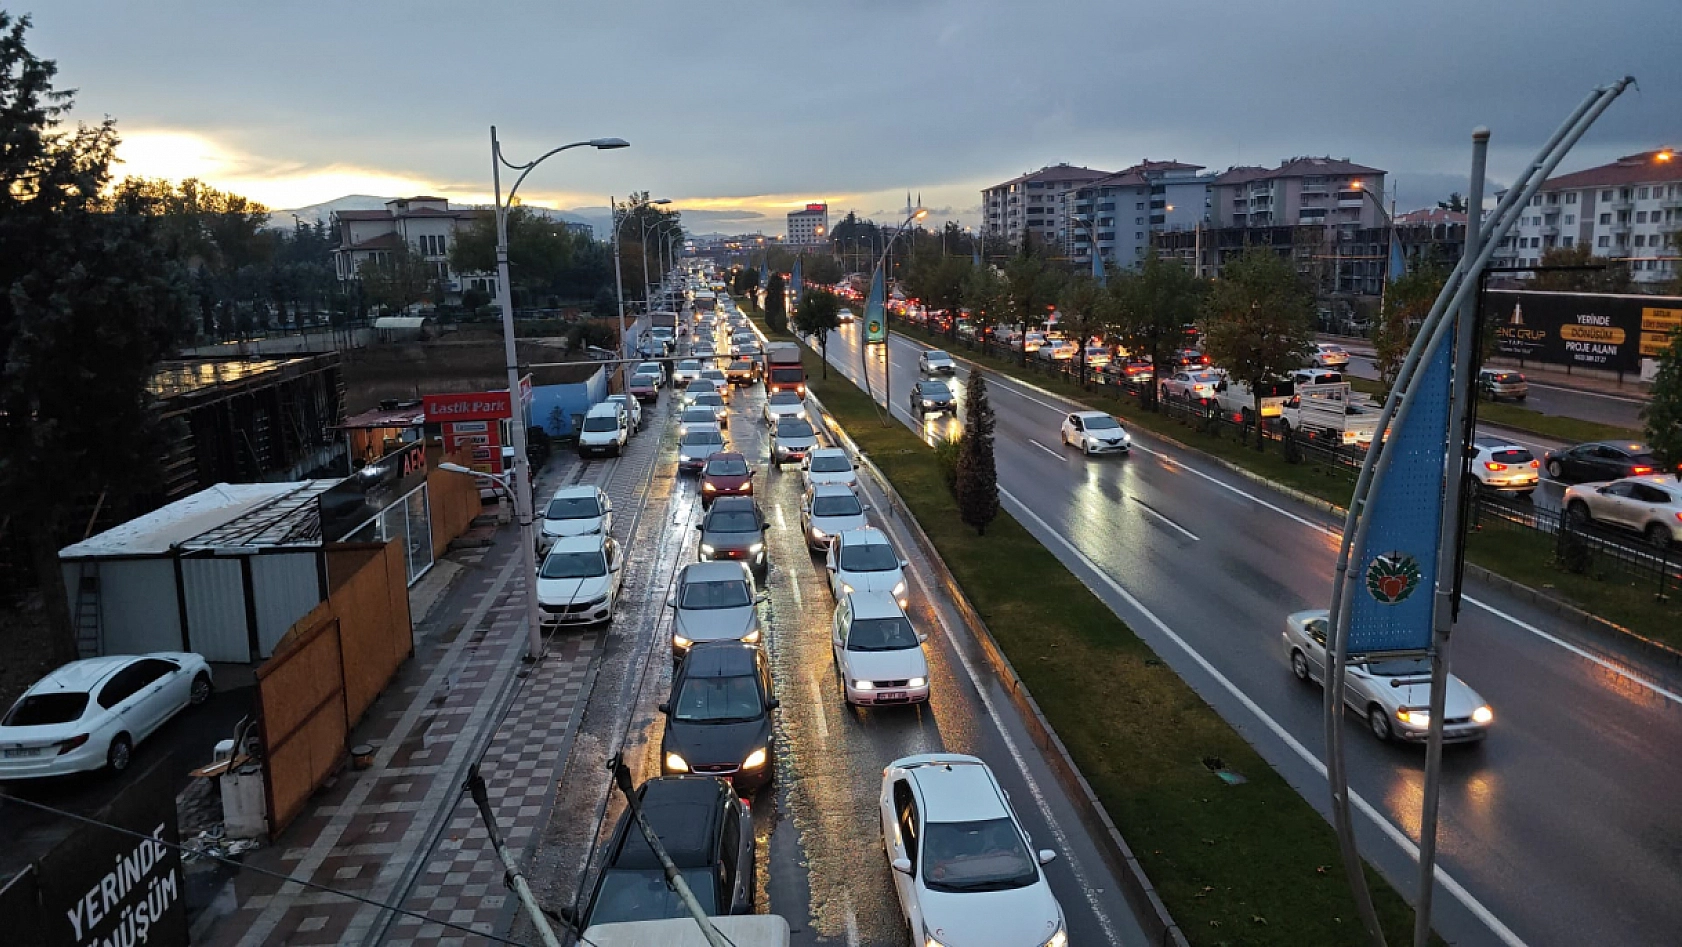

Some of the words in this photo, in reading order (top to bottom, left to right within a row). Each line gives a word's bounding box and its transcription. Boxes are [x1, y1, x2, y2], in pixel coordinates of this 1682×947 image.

[1577, 313, 1610, 326] YERİNDE
[1517, 329, 1547, 340] GRUP
[1566, 341, 1591, 352] PROJE
[1592, 344, 1617, 356] ALANI
[430, 402, 469, 415] Lastik
[473, 401, 505, 412] Park
[67, 822, 167, 942] YERİNDE
[87, 867, 178, 947] NÜŞÜM
